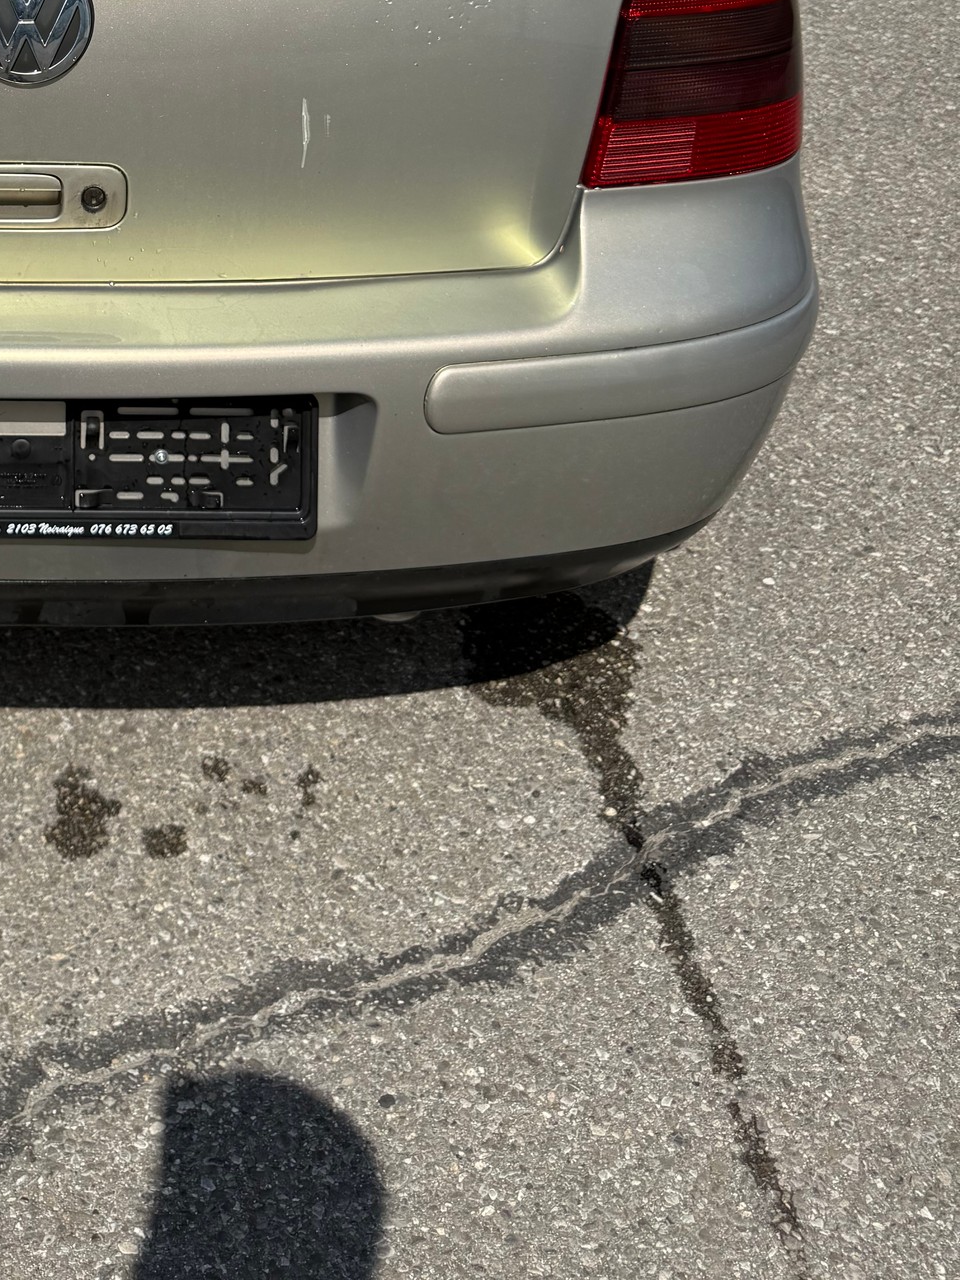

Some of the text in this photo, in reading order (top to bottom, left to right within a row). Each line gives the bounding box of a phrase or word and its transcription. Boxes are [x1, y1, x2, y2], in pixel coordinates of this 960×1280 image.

[6, 523, 36, 534] 2103
[38, 522, 85, 537] Noiraigue
[90, 523, 113, 535] 076
[115, 523, 137, 535] 673
[140, 524, 155, 535] 65
[157, 524, 173, 535] 05
